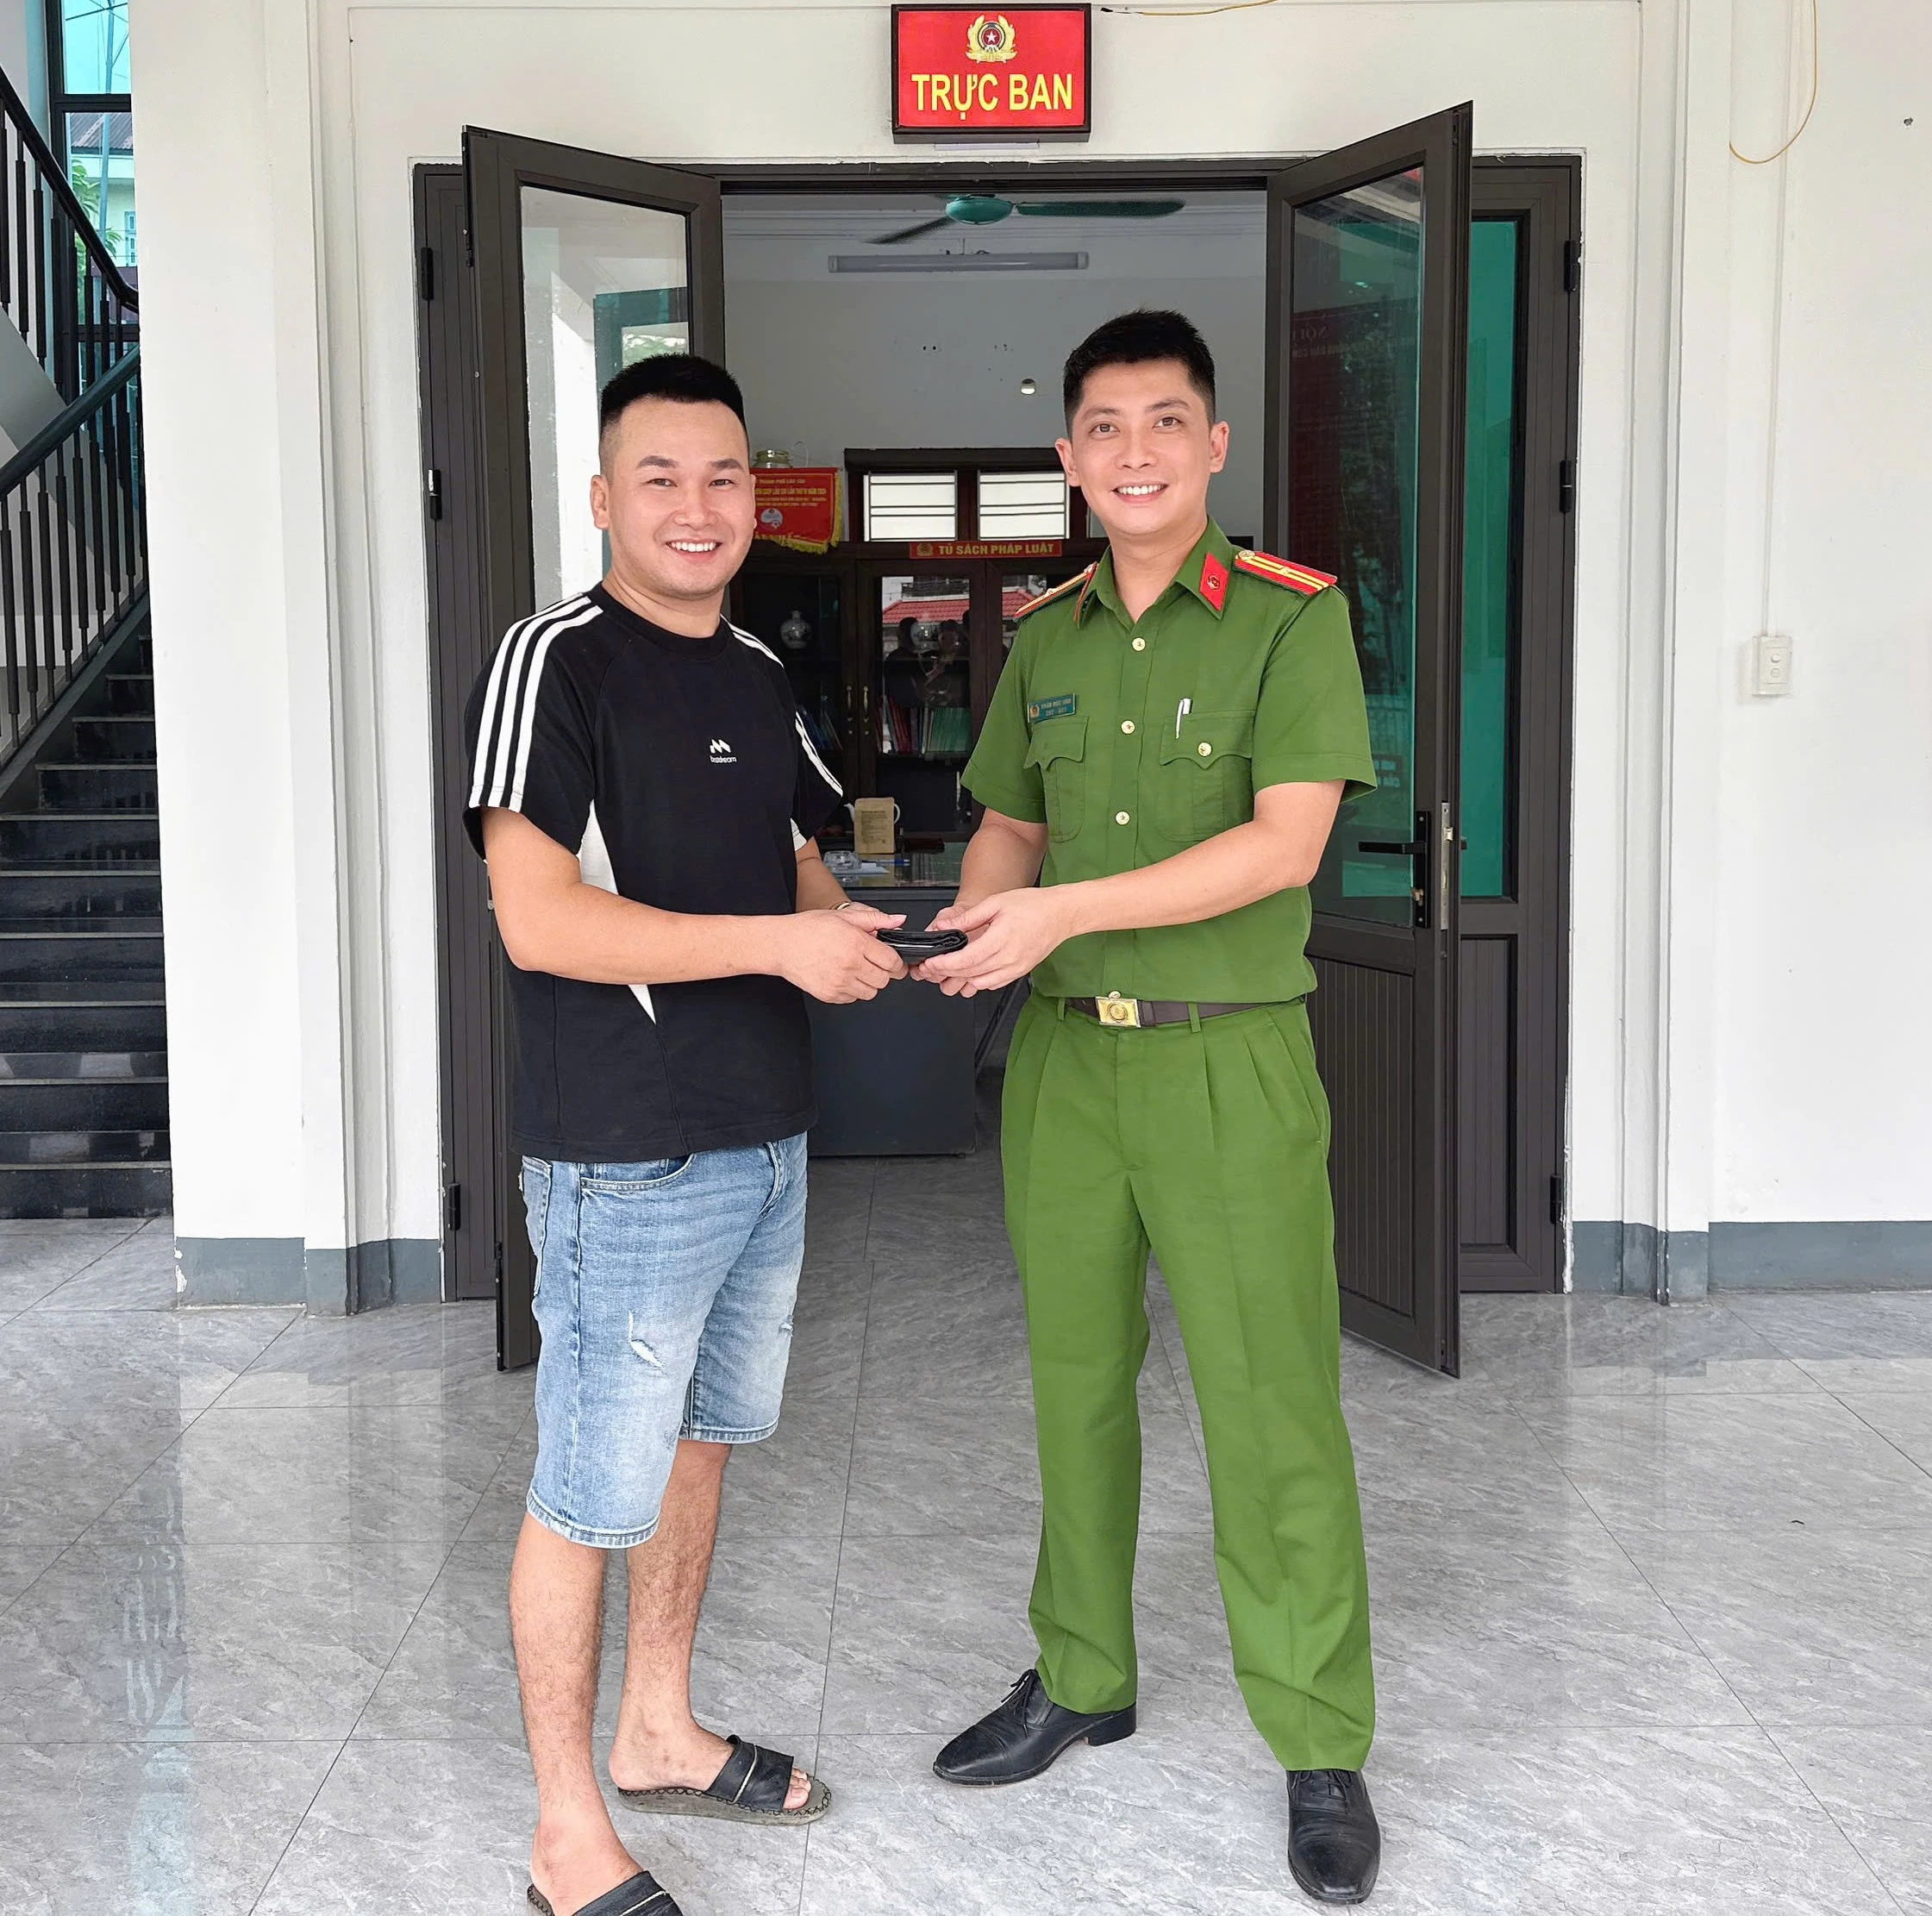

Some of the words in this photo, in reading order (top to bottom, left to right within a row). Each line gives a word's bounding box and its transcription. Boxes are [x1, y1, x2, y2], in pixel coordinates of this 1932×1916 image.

[911, 73, 998, 120] TRỰC
[1009, 73, 1072, 110] BAN
[956, 543, 988, 554] SÁCH
[991, 542, 1022, 554] PHÁP
